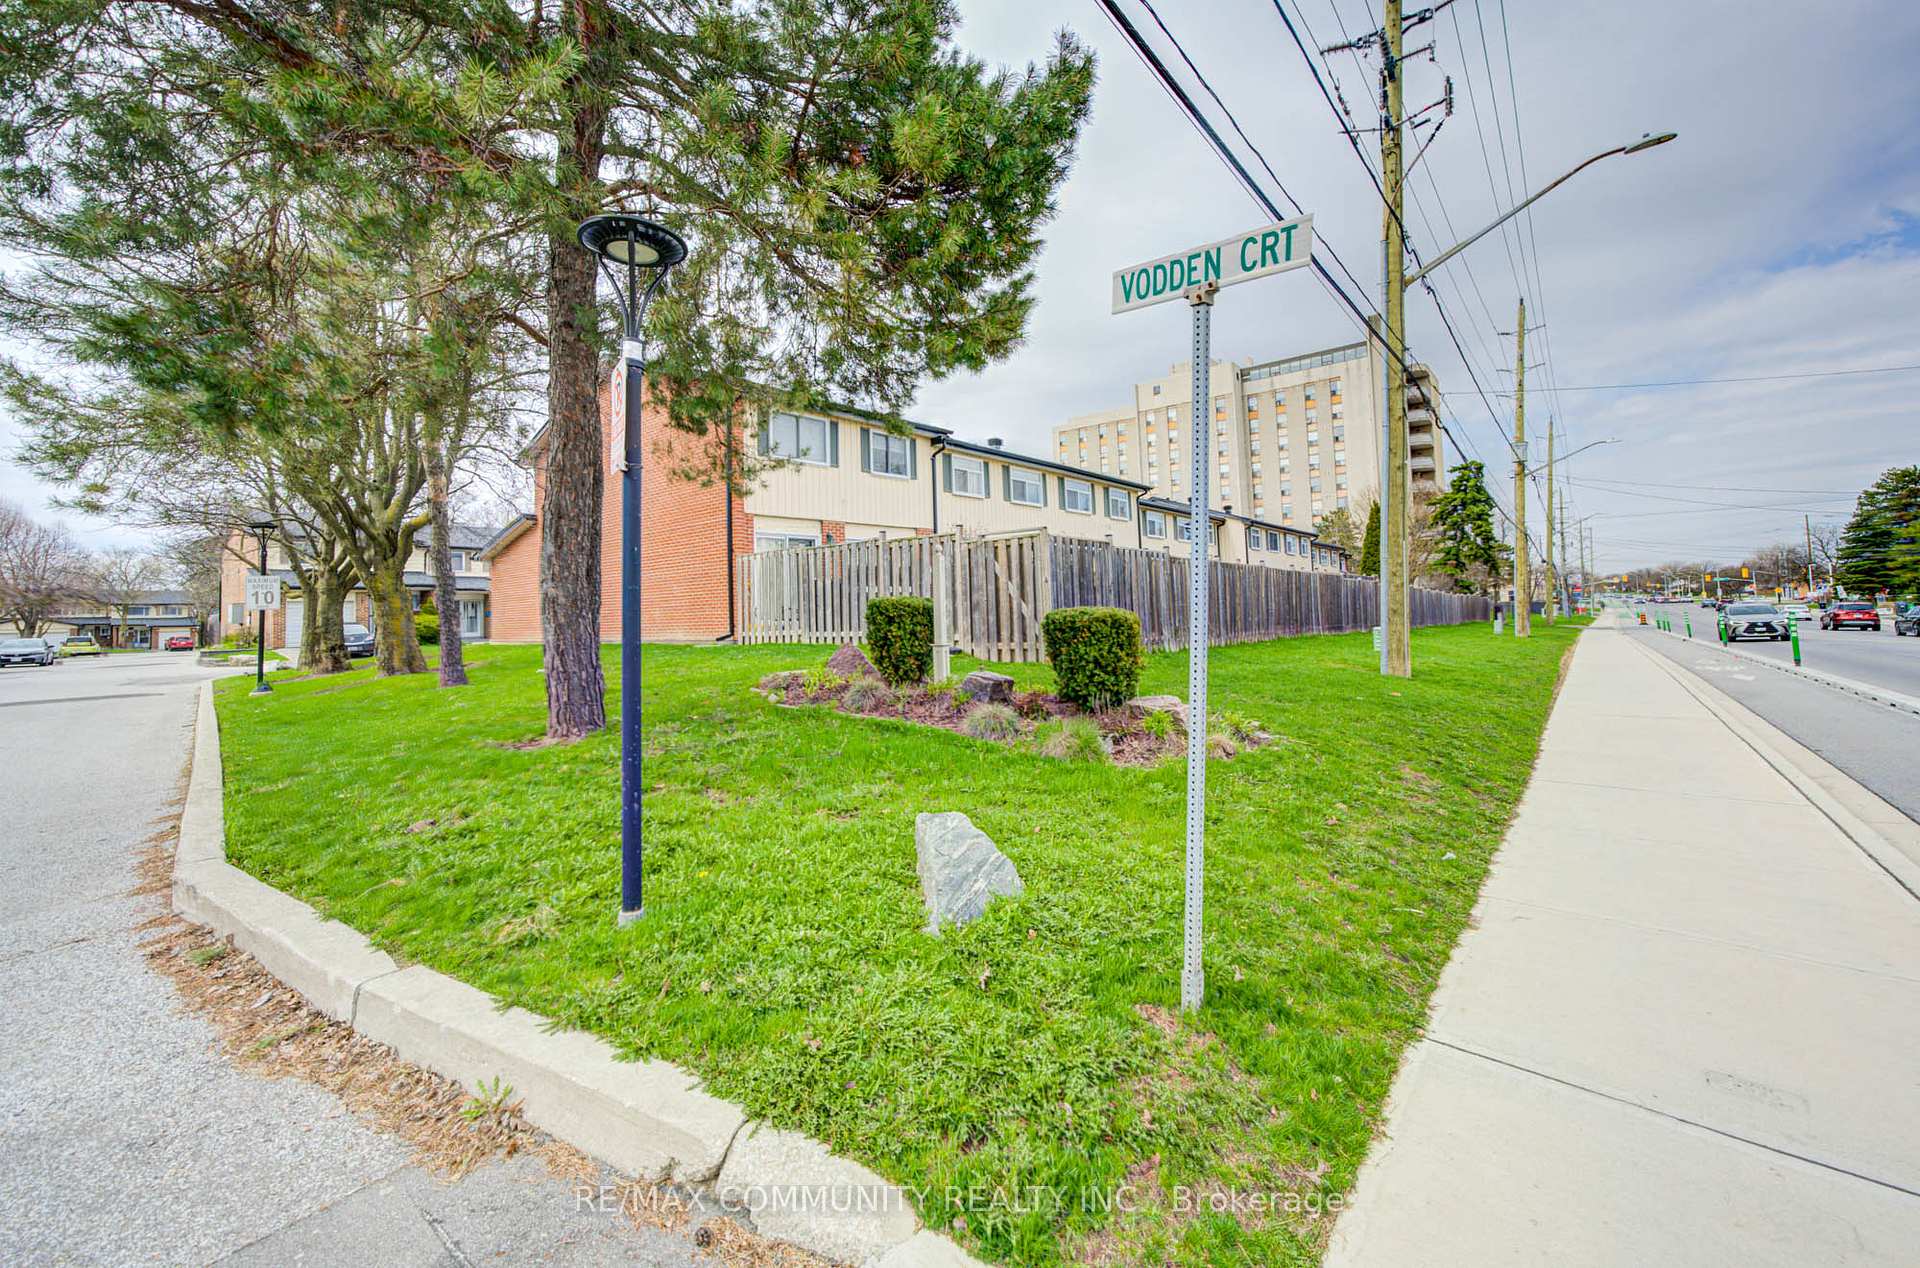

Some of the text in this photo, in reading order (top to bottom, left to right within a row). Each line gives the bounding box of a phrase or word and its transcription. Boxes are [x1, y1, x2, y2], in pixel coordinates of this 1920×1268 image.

[1120, 223, 1298, 303] VODDEN CRT
[251, 590, 274, 605] 10
